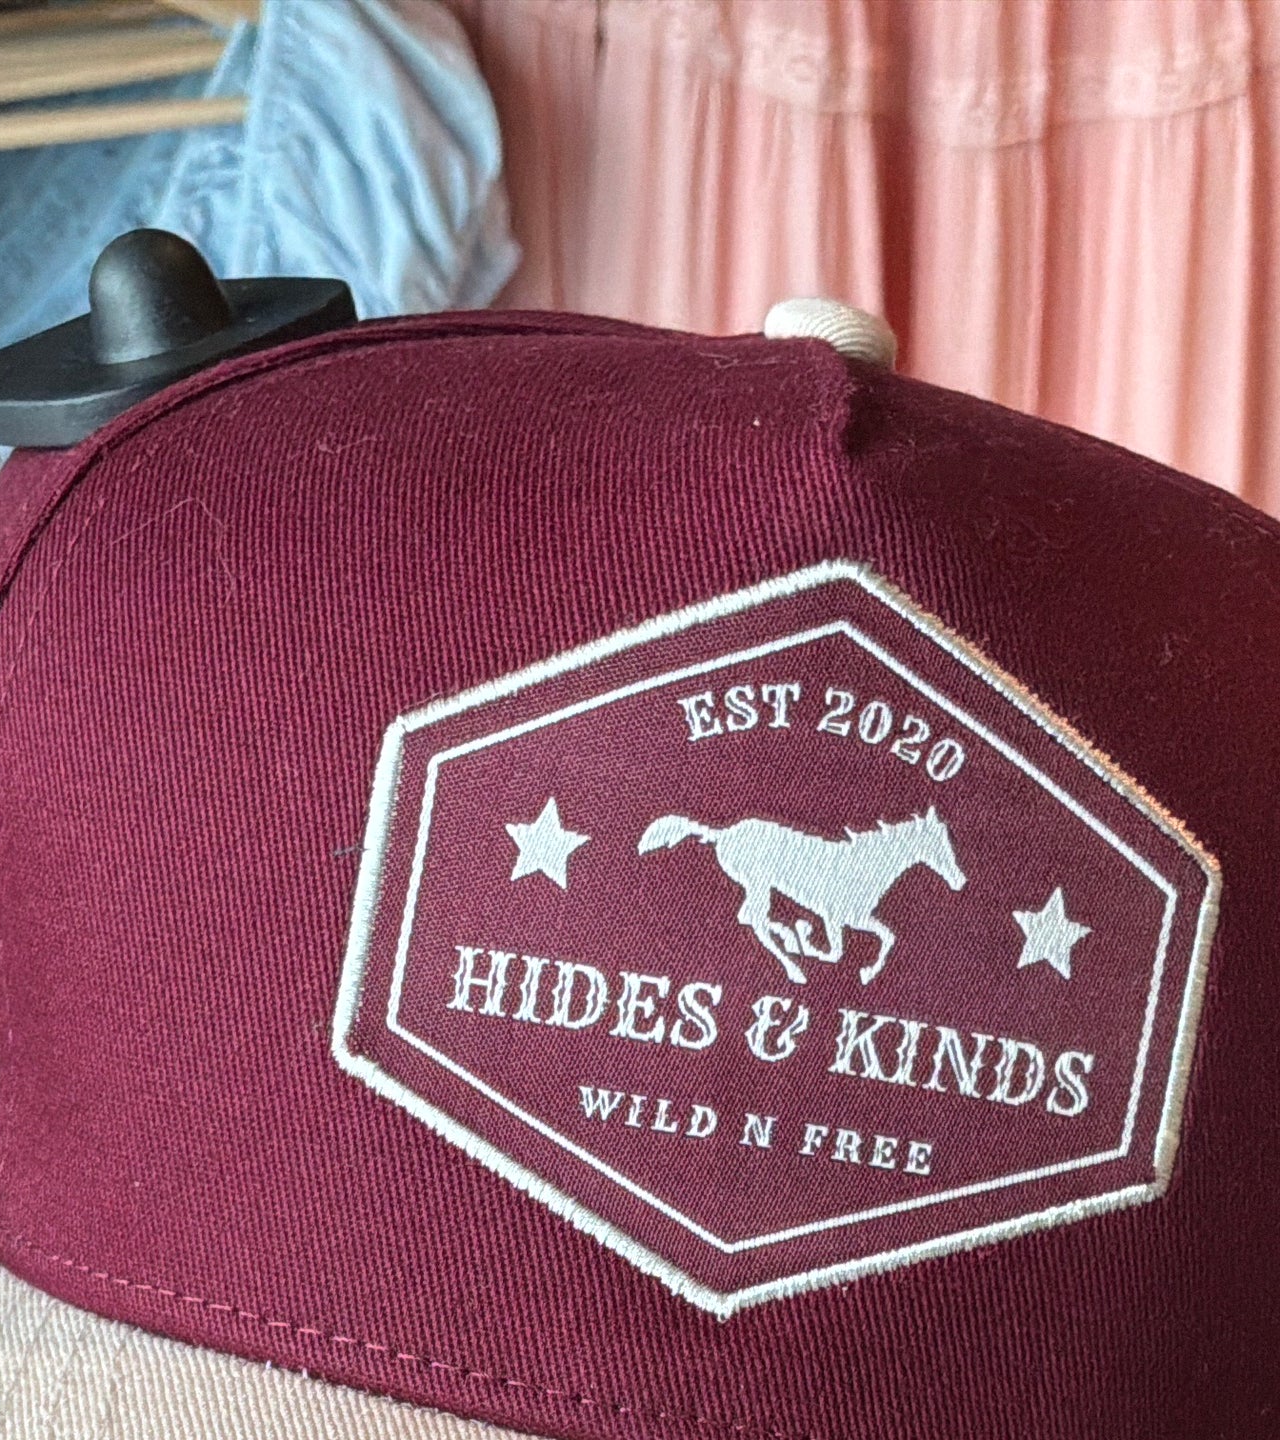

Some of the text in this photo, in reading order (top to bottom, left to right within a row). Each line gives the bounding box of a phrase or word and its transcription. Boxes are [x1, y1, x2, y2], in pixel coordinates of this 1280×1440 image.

[677, 684, 967, 783] EST 2020
[446, 945, 1097, 1117] HIDES & KINDS
[579, 1086, 933, 1176] WILD N FREE
